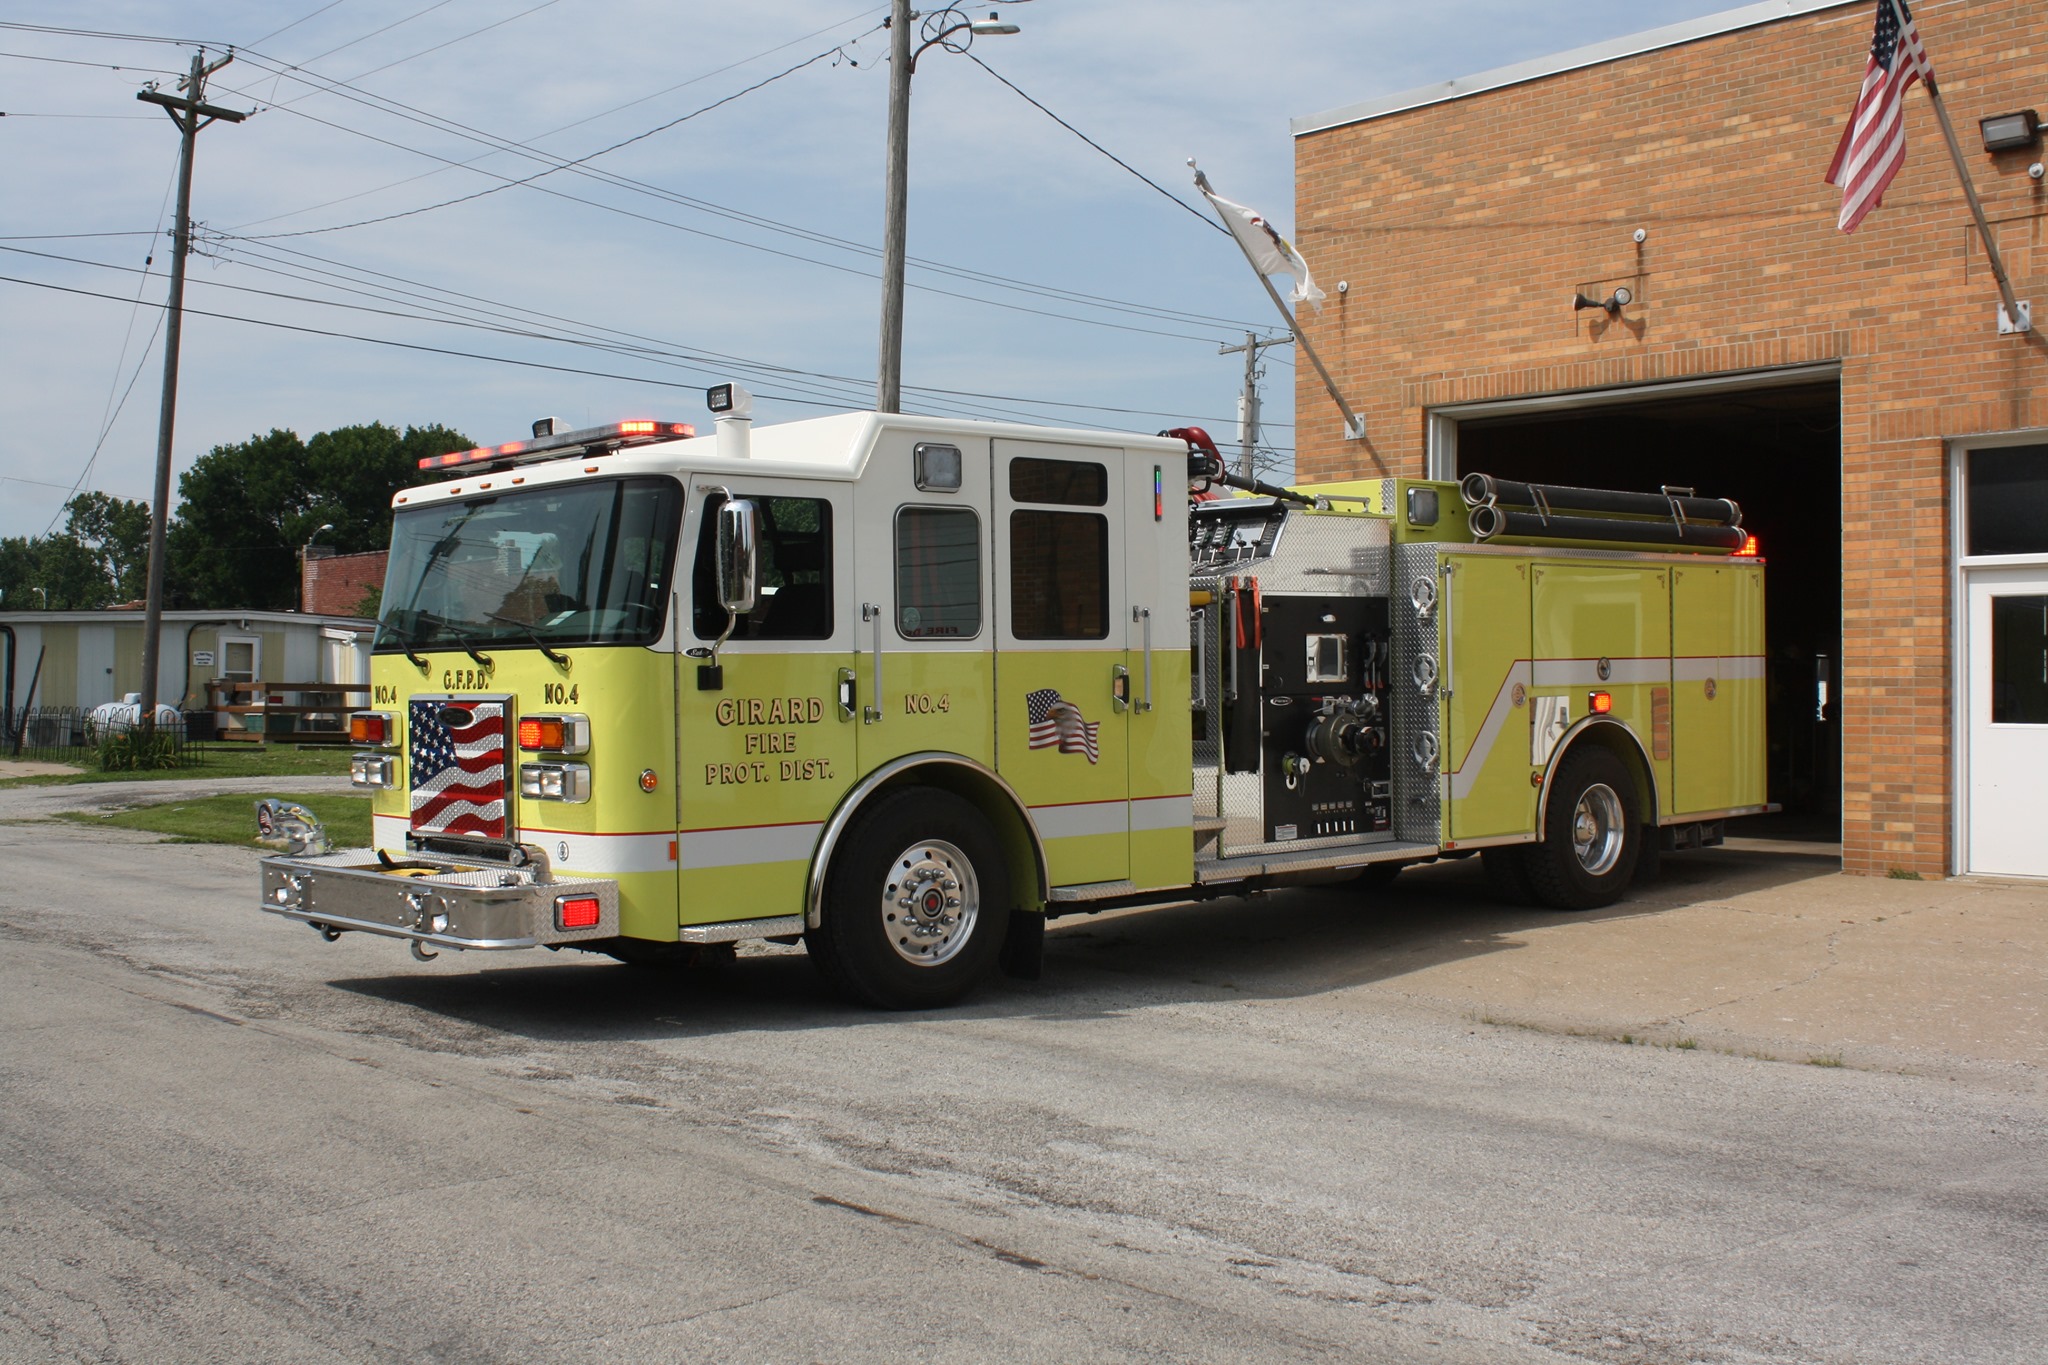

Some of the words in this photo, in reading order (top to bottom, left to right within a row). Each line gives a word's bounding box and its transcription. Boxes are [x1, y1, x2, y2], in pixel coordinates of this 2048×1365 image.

[443, 669, 489, 690] G.F.P.D.
[374, 685, 397, 704] NO.4
[544, 683, 579, 705] NO.4
[716, 698, 824, 726] GIRARD
[745, 732, 797, 754] FIRE
[705, 763, 770, 785] PROT.
[781, 758, 836, 781] DIST.
